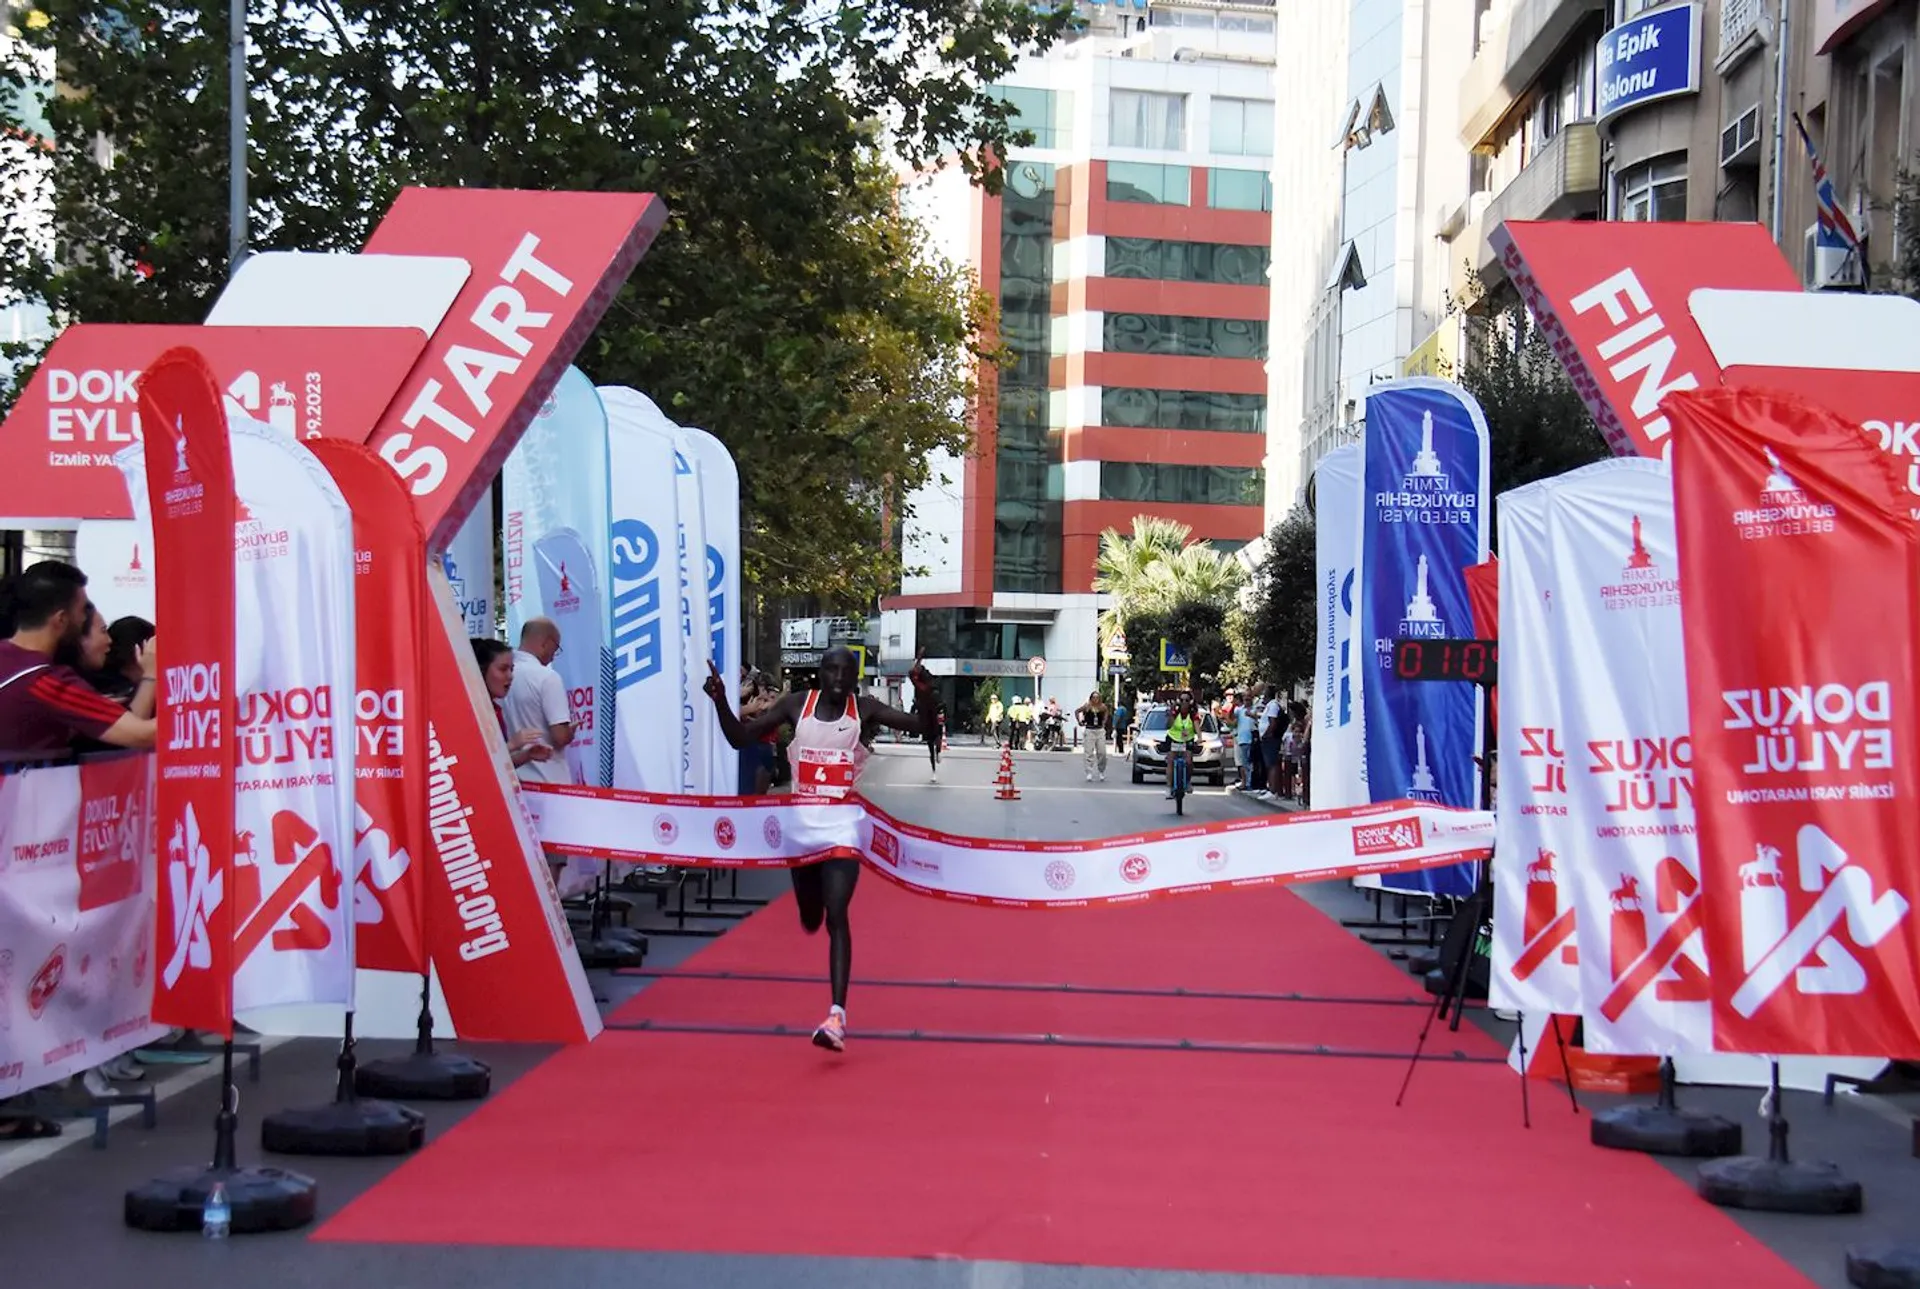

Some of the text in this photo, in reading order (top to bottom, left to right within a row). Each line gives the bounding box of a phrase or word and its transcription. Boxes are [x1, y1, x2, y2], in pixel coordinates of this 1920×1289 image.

[1616, 24, 1662, 63] Epik
[1601, 68, 1657, 107] Salonu
[378, 231, 574, 496] START
[1570, 266, 1699, 471] FIN
[48, 369, 143, 403] DOK
[305, 371, 322, 440] 09.2023
[48, 408, 144, 442] EYL
[49, 450, 91, 466] İZMİR
[429, 720, 510, 962] tonizmir.org
